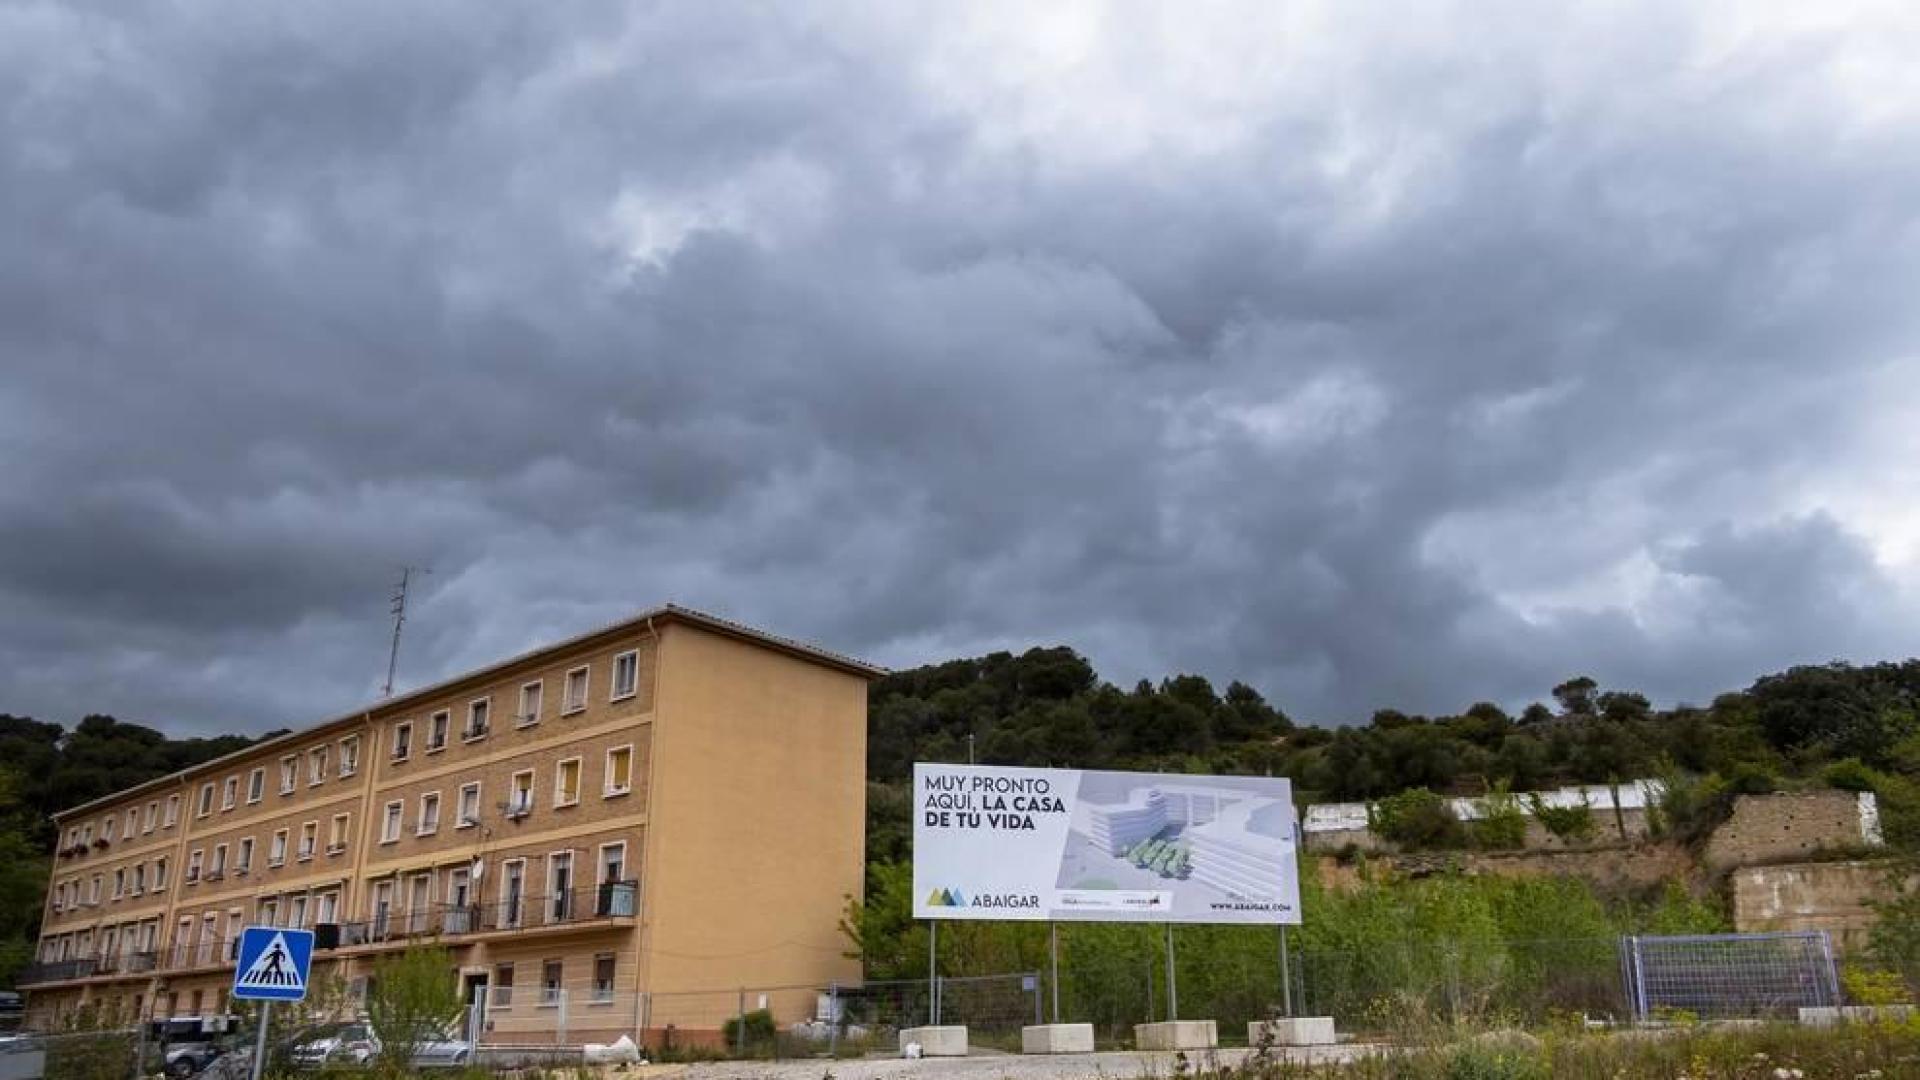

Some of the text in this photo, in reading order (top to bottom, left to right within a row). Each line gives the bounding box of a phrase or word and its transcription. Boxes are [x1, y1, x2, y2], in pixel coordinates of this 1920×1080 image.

[925, 775, 1050, 793] MUY PRONTO
[925, 791, 1066, 813] AQUÍ, LA CASA
[925, 811, 1035, 830] DE TU VIDA
[972, 893, 1039, 908] ABAIGAR
